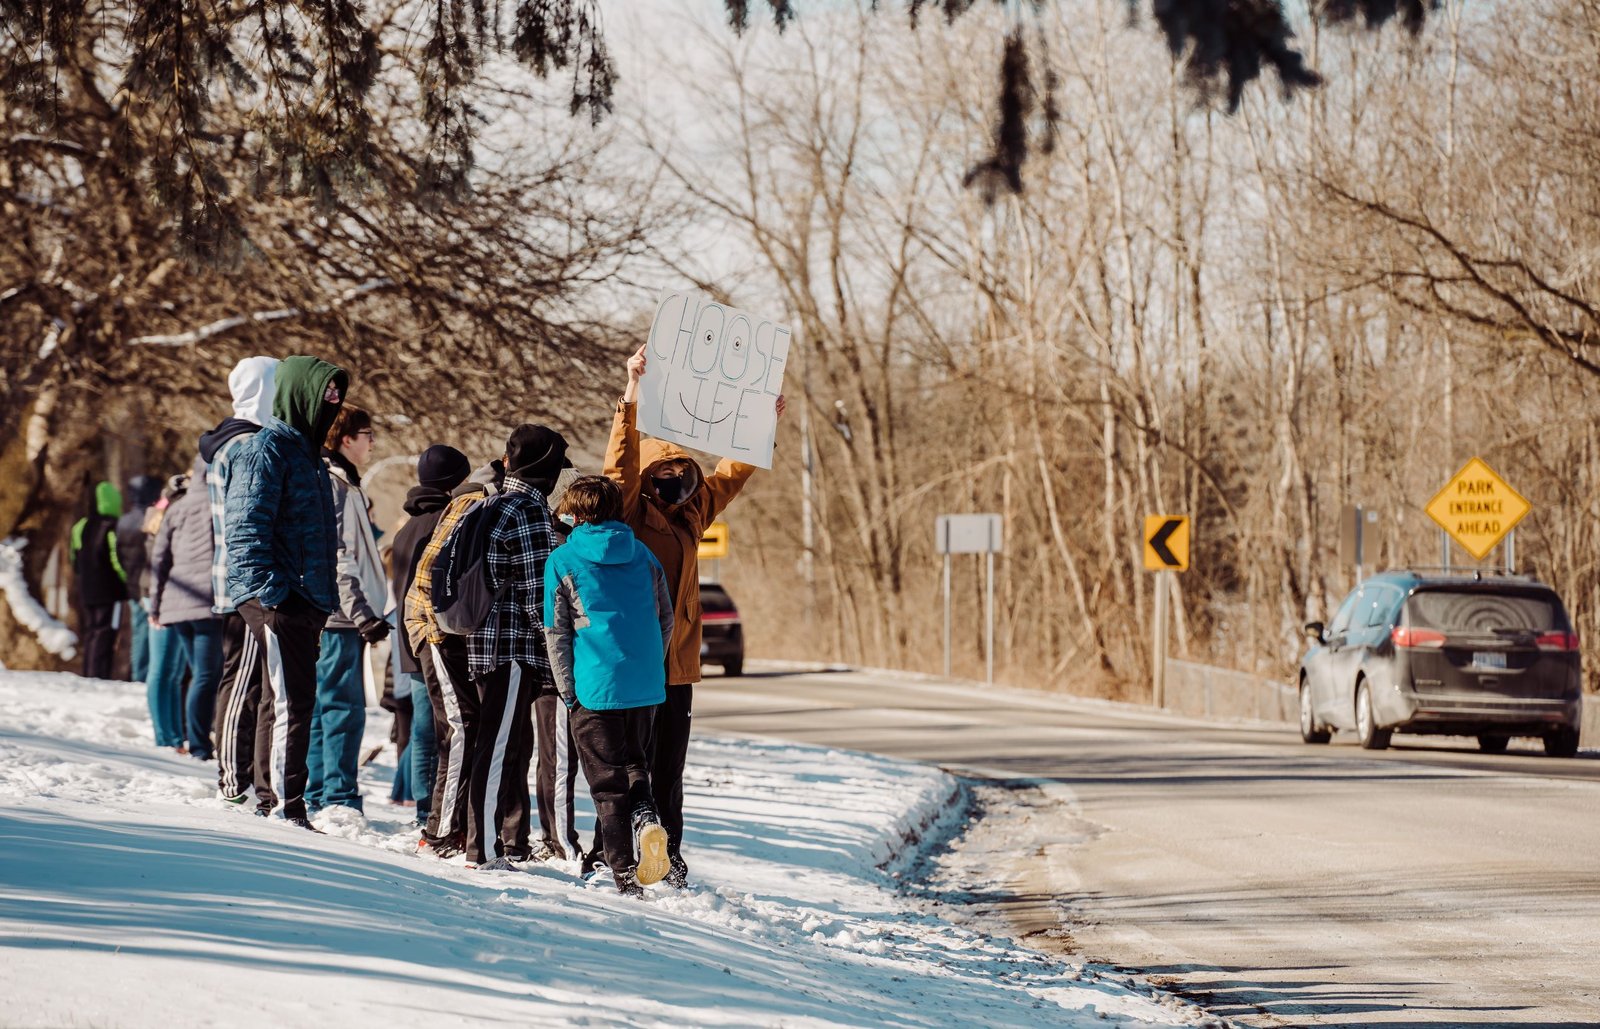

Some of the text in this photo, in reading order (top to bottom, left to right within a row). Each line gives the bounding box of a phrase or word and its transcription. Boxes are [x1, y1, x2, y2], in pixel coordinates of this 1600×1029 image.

[651, 294, 790, 397] CHOOSE
[660, 372, 761, 451] LIFE
[1457, 481, 1495, 495] PARK
[1449, 501, 1504, 516] ENTRANCE
[1457, 520, 1501, 535] AHEAD
